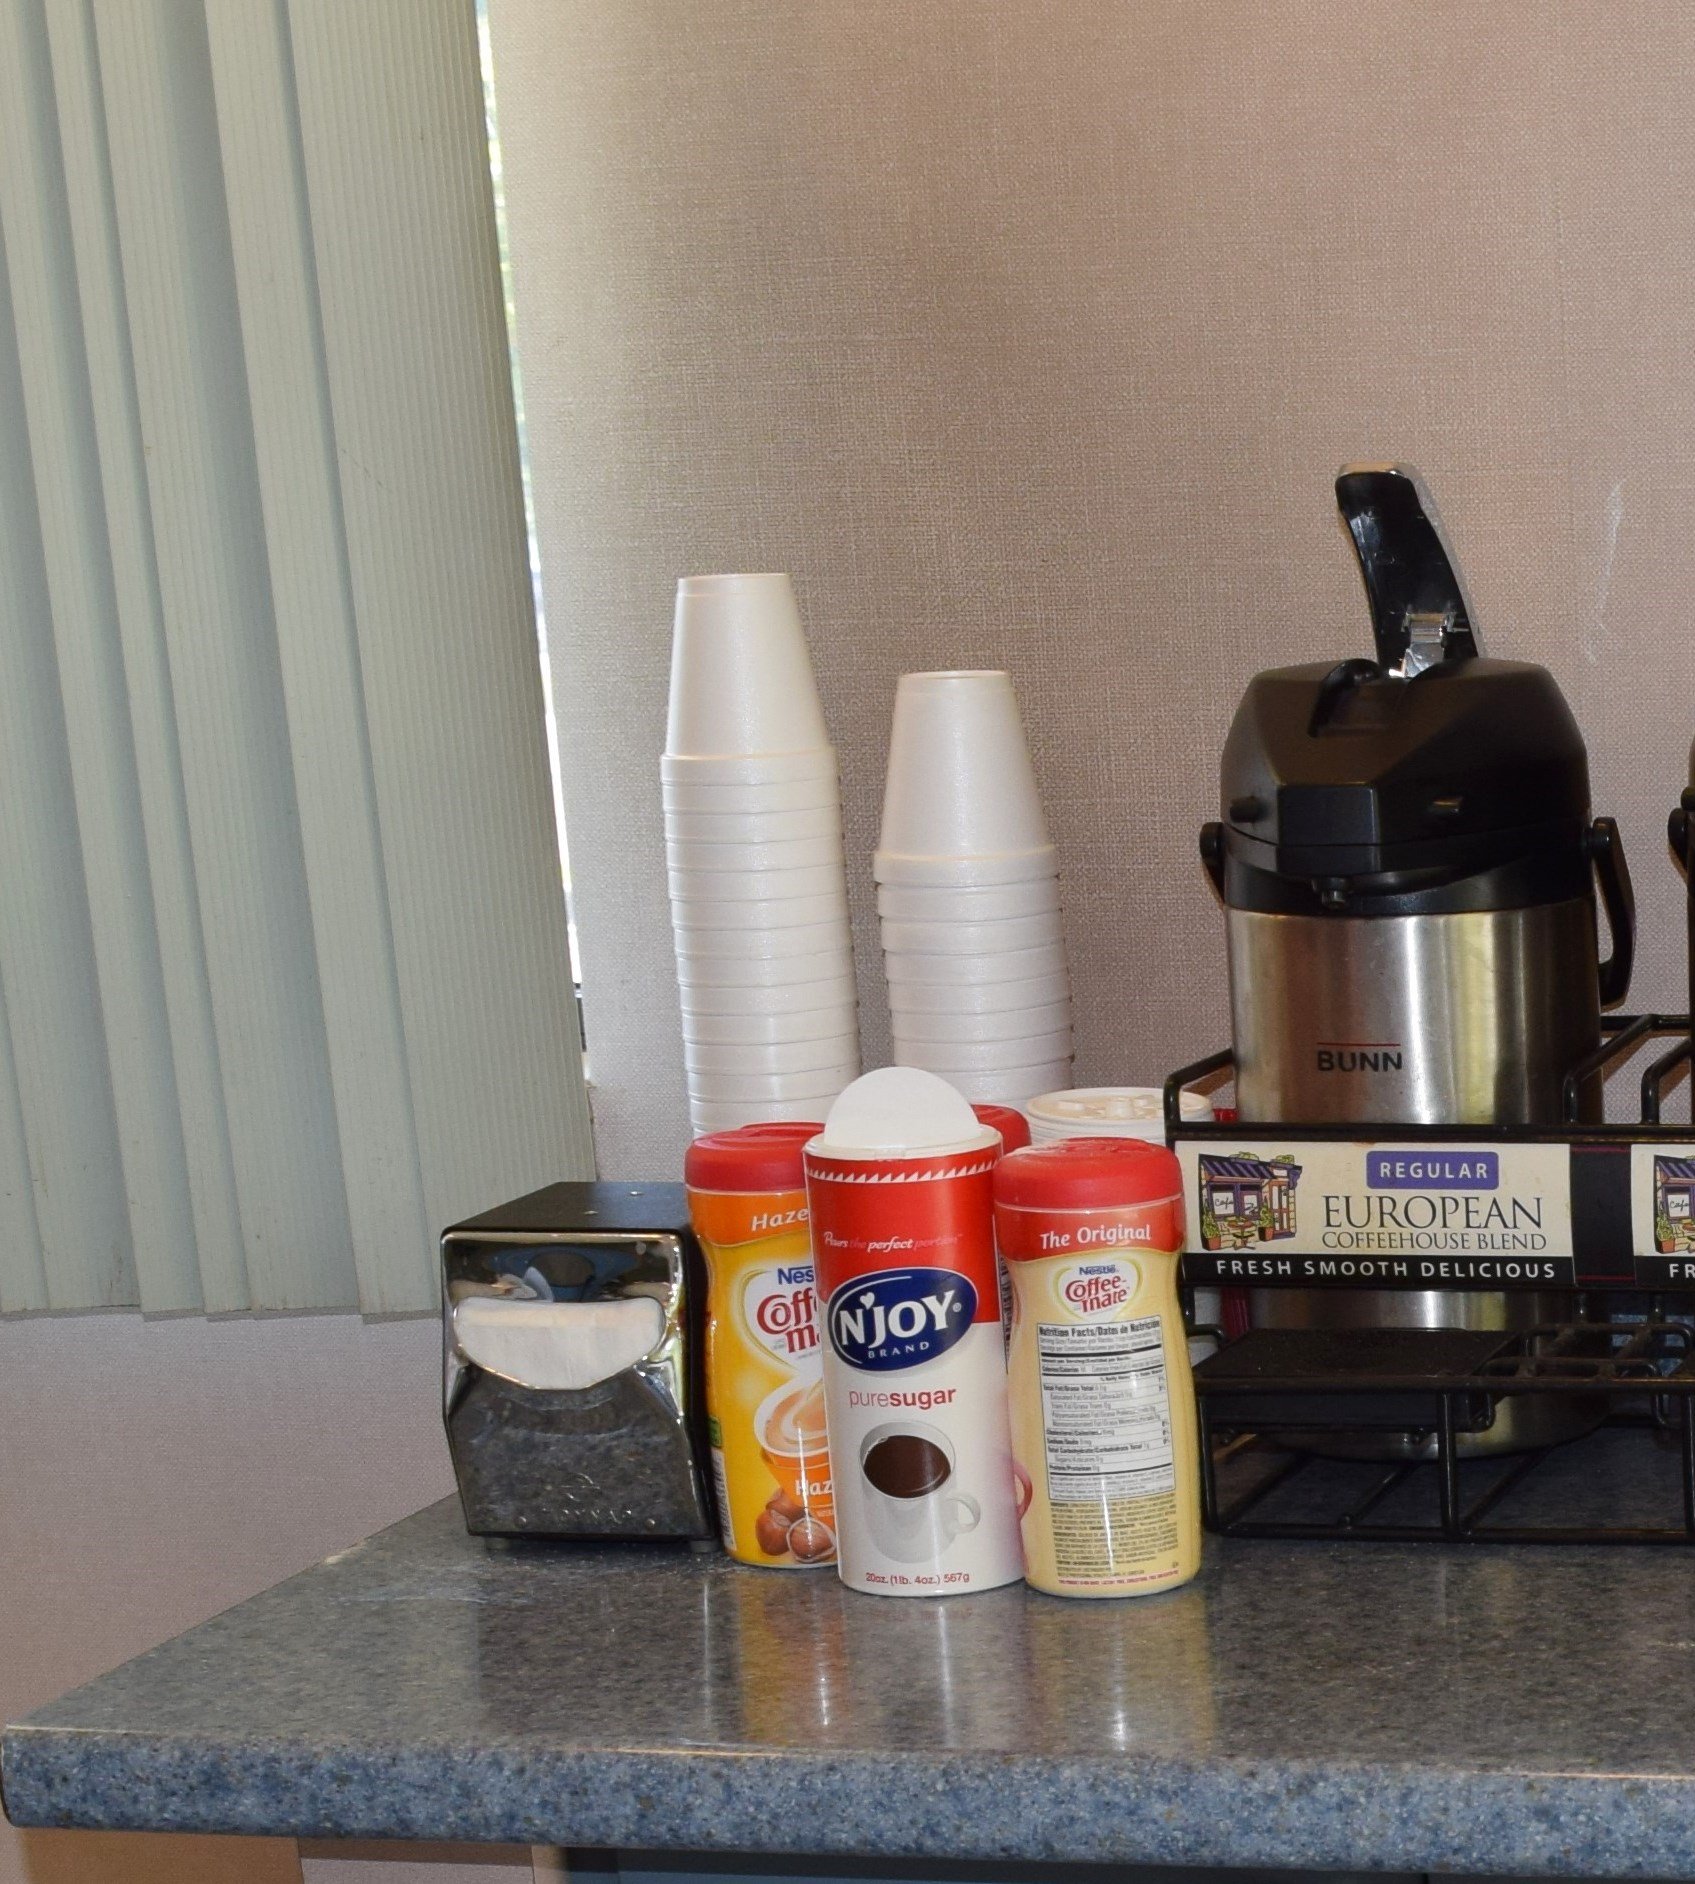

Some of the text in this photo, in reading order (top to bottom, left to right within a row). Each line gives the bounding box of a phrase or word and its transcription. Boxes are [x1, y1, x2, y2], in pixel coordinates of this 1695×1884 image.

[1317, 1050, 1402, 1072] BUNN
[1380, 1162, 1488, 1179] REGULAR
[751, 1206, 809, 1231] Haze
[1322, 1195, 1543, 1230] EUROPEAN
[867, 1235, 914, 1253] perfect
[1040, 1224, 1151, 1250] The Original
[1322, 1231, 1547, 1250] COFFEEHOUSE BLEND
[1216, 1260, 1555, 1279] FRESH SMOOTH DELICIOUS
[756, 1287, 818, 1335] Coff
[1081, 1288, 1128, 1313] mate
[868, 1341, 929, 1359] BRAND
[849, 1387, 957, 1411] puresugar
